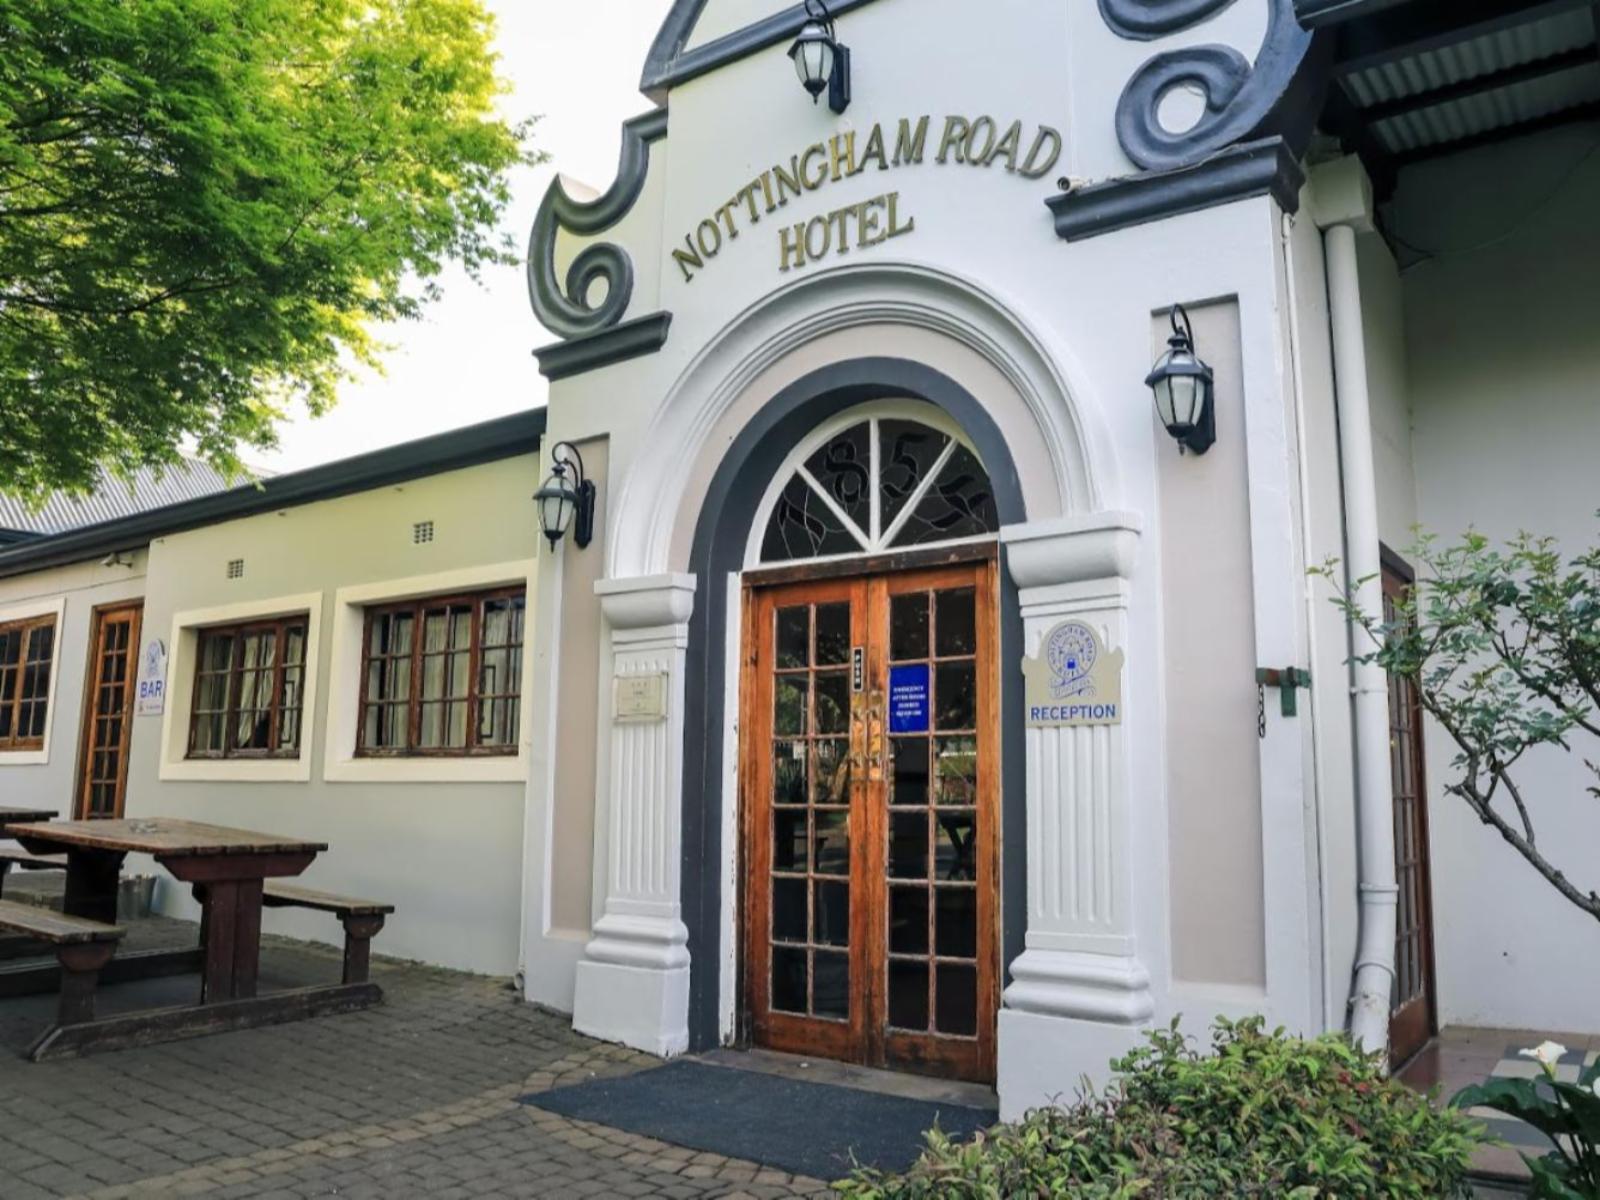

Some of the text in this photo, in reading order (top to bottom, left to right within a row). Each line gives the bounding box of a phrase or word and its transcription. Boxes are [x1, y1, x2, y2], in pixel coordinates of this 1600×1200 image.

[672, 115, 1062, 282] NOTTINGHAM ROAD
[778, 192, 914, 271] HOTEL
[140, 681, 162, 697] BAR
[1031, 704, 1115, 720] RECEPTION
